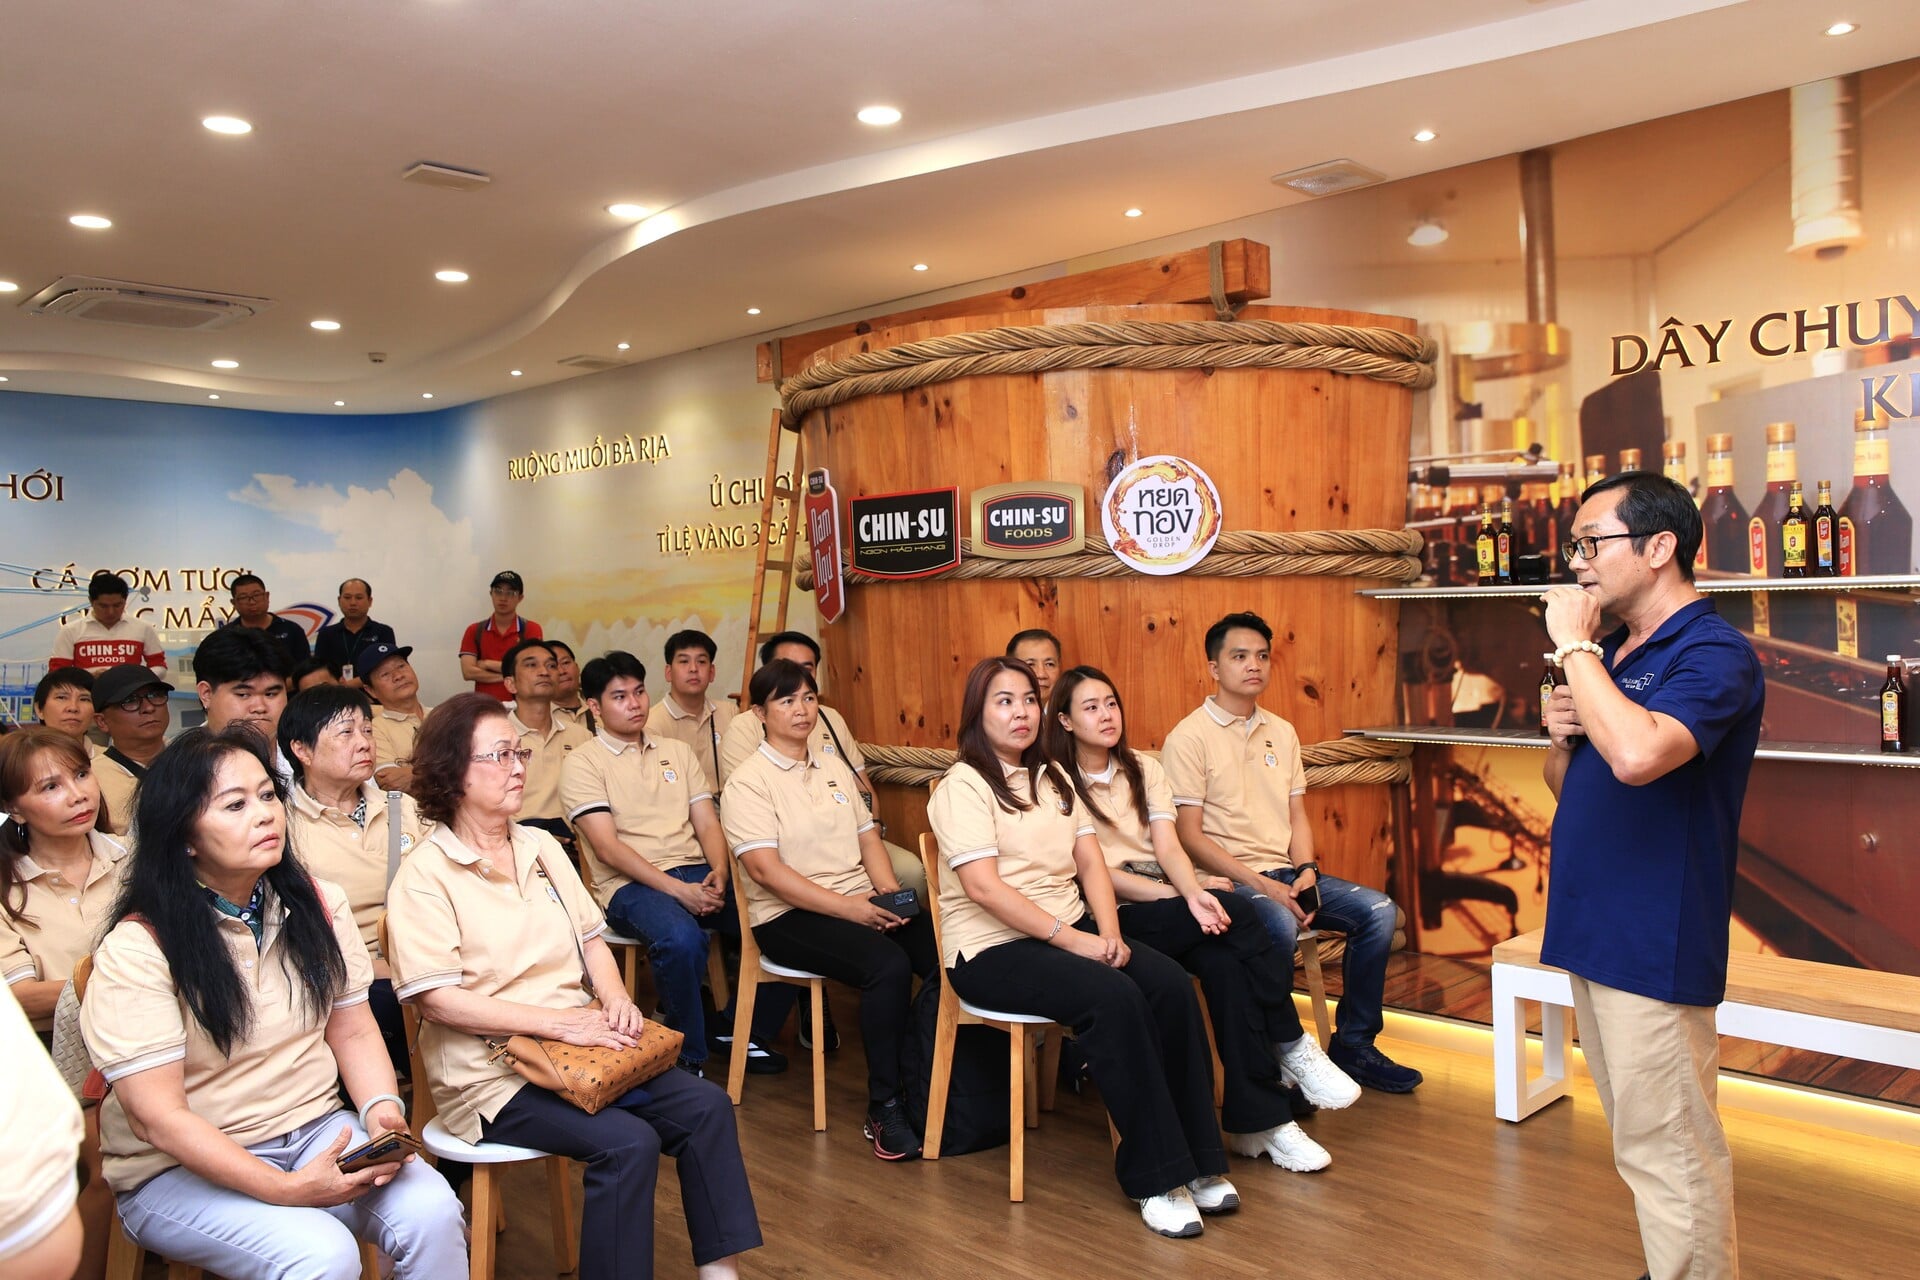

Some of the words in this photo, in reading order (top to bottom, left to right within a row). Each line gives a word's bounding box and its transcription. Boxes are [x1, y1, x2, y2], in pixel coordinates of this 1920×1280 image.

[1611, 316, 1734, 377] DÂY
[508, 450, 560, 483] RUỘNG
[612, 435, 634, 464] BÀ
[639, 434, 669, 466] RỊA
[710, 474, 723, 508] Ủ
[1138, 488, 1189, 508] หยด
[859, 508, 946, 543] CHIN-SU
[990, 506, 1065, 527] CHIN-SU
[1133, 508, 1194, 536] ทอง
[657, 524, 671, 552] TỈ
[674, 525, 691, 556] LỆ
[695, 522, 745, 550] VÀNG
[1005, 528, 1053, 539] FOODS
[32, 563, 79, 592] CÁ
[180, 567, 253, 592] TƯƠ
[79, 644, 135, 657] CHIN-SU
[91, 656, 126, 664] FOODS
